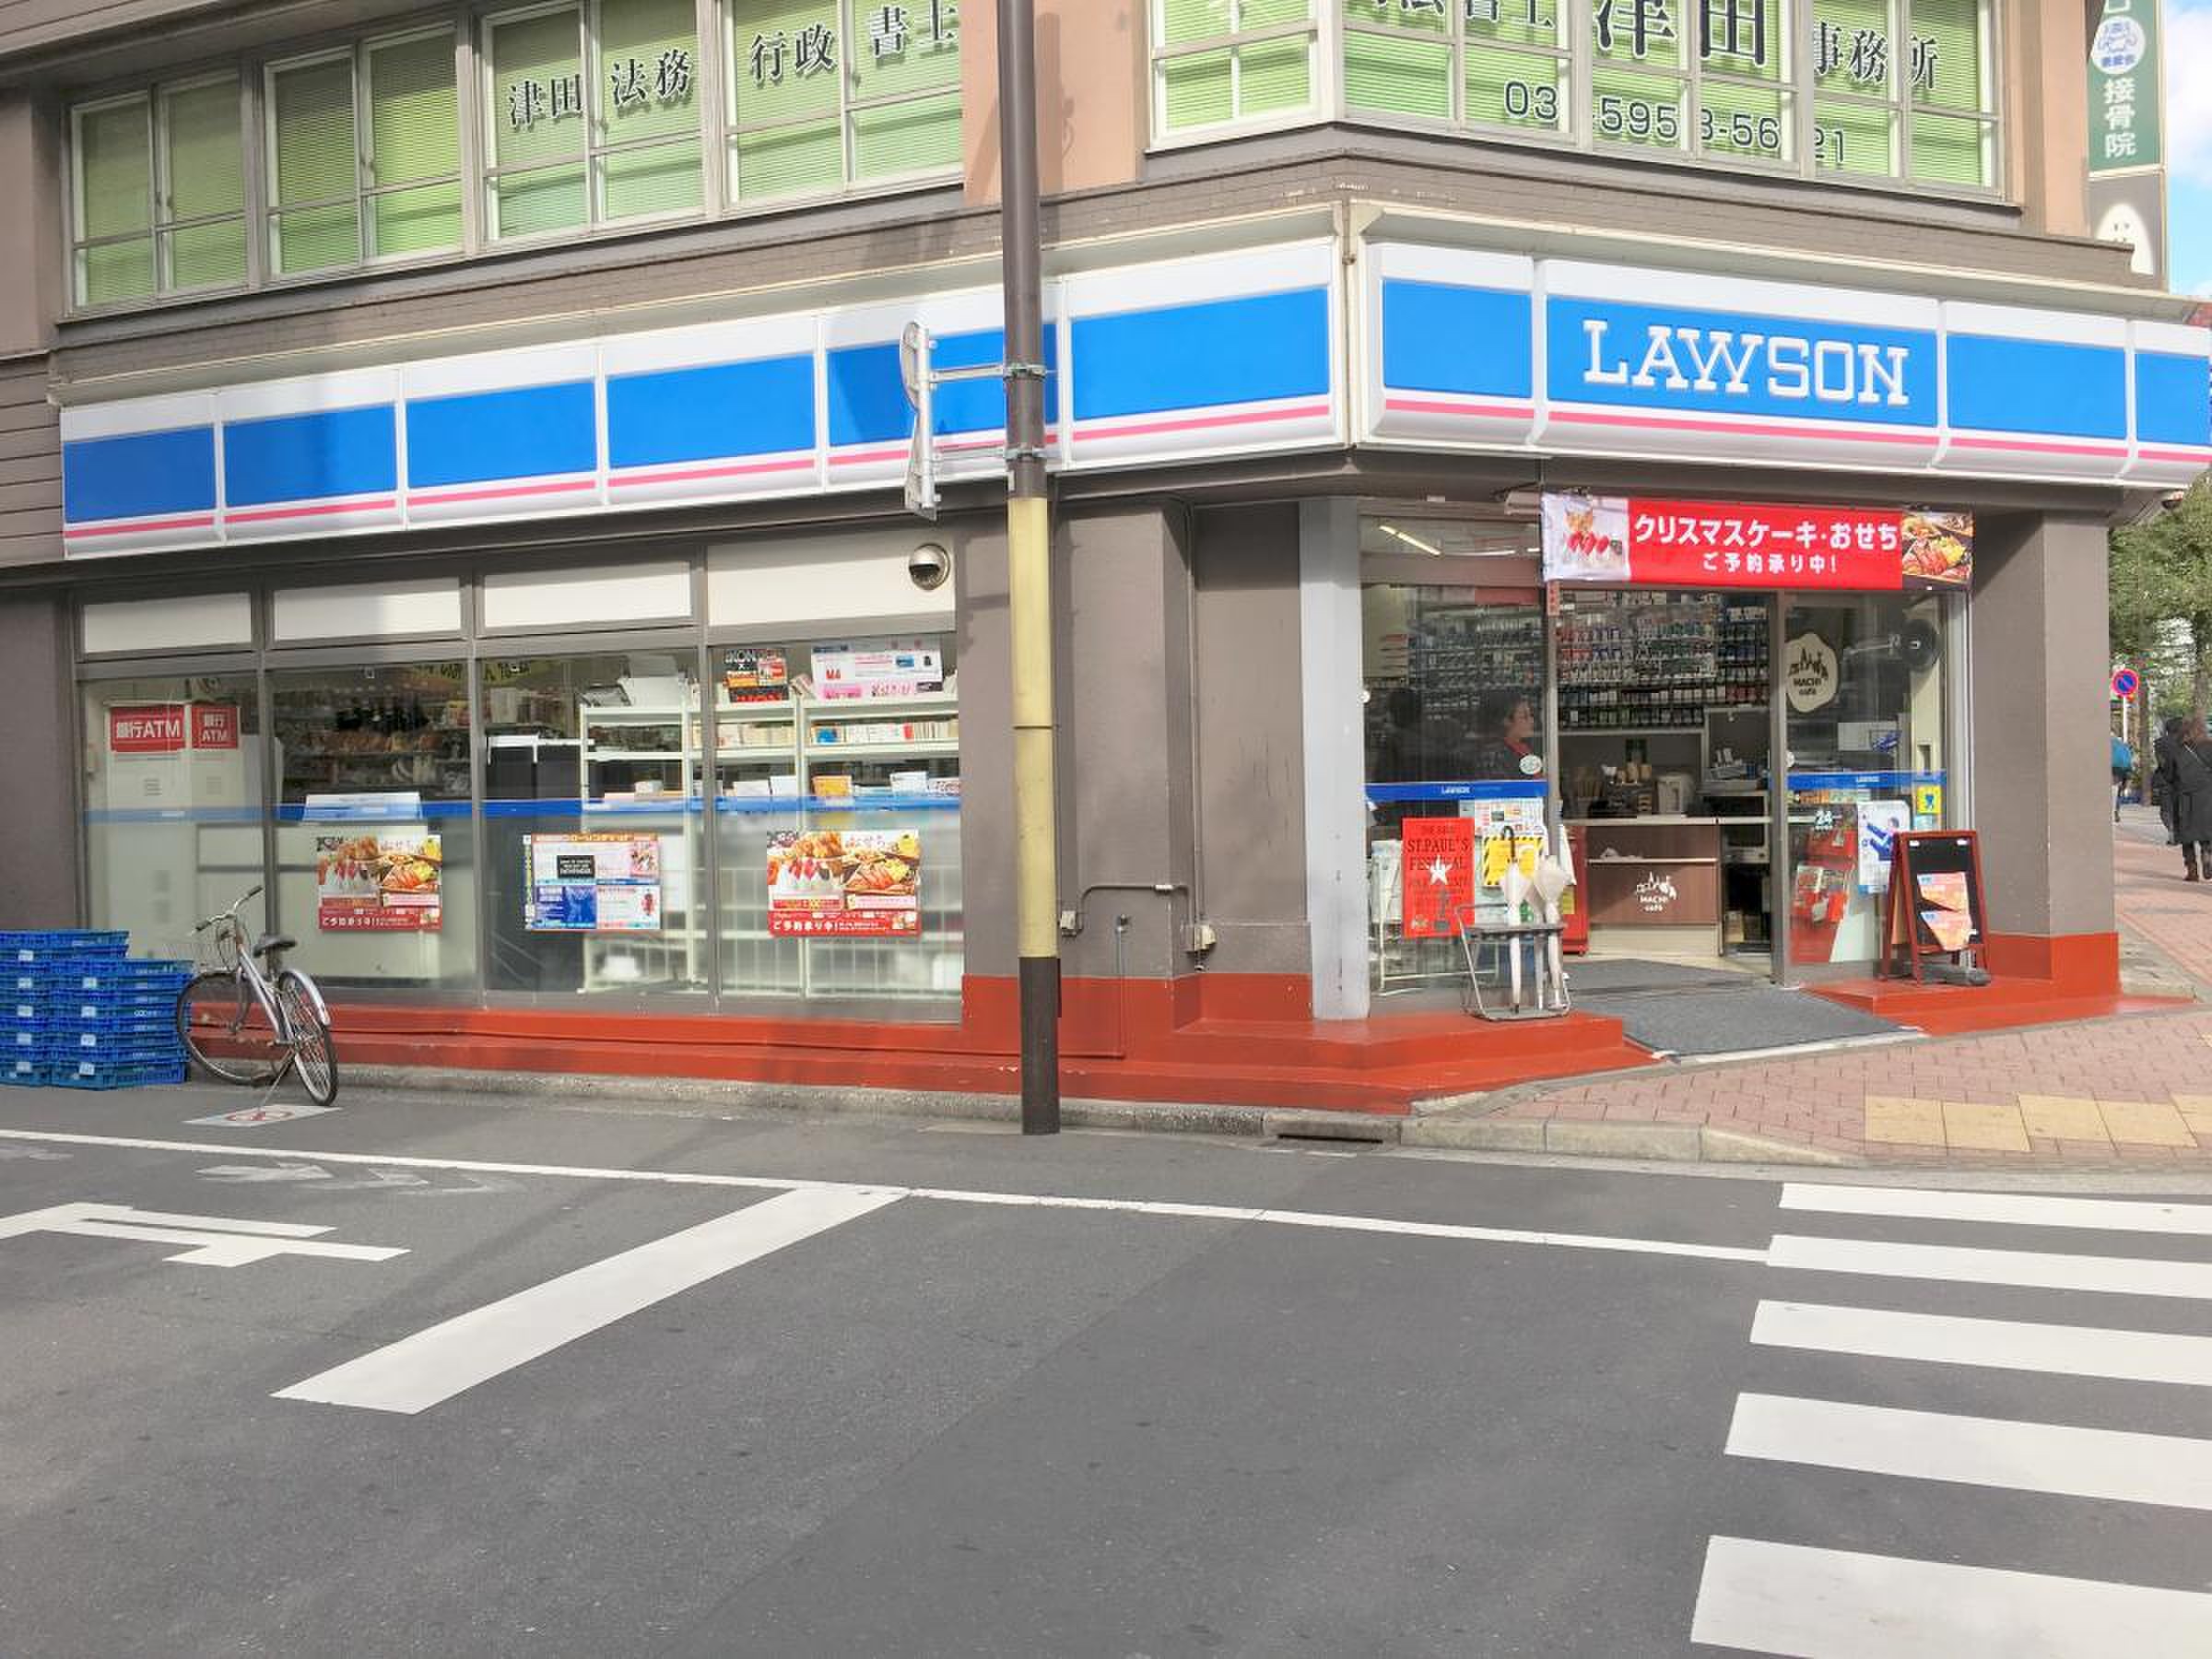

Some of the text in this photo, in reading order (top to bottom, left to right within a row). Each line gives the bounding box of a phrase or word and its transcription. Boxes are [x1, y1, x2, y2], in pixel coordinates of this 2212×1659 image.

[2103, 77, 2136, 159] 接骨院
[1583, 319, 1910, 406] LAWSON
[116, 719, 181, 738] 銀行ATM
[202, 728, 228, 742] ATM
